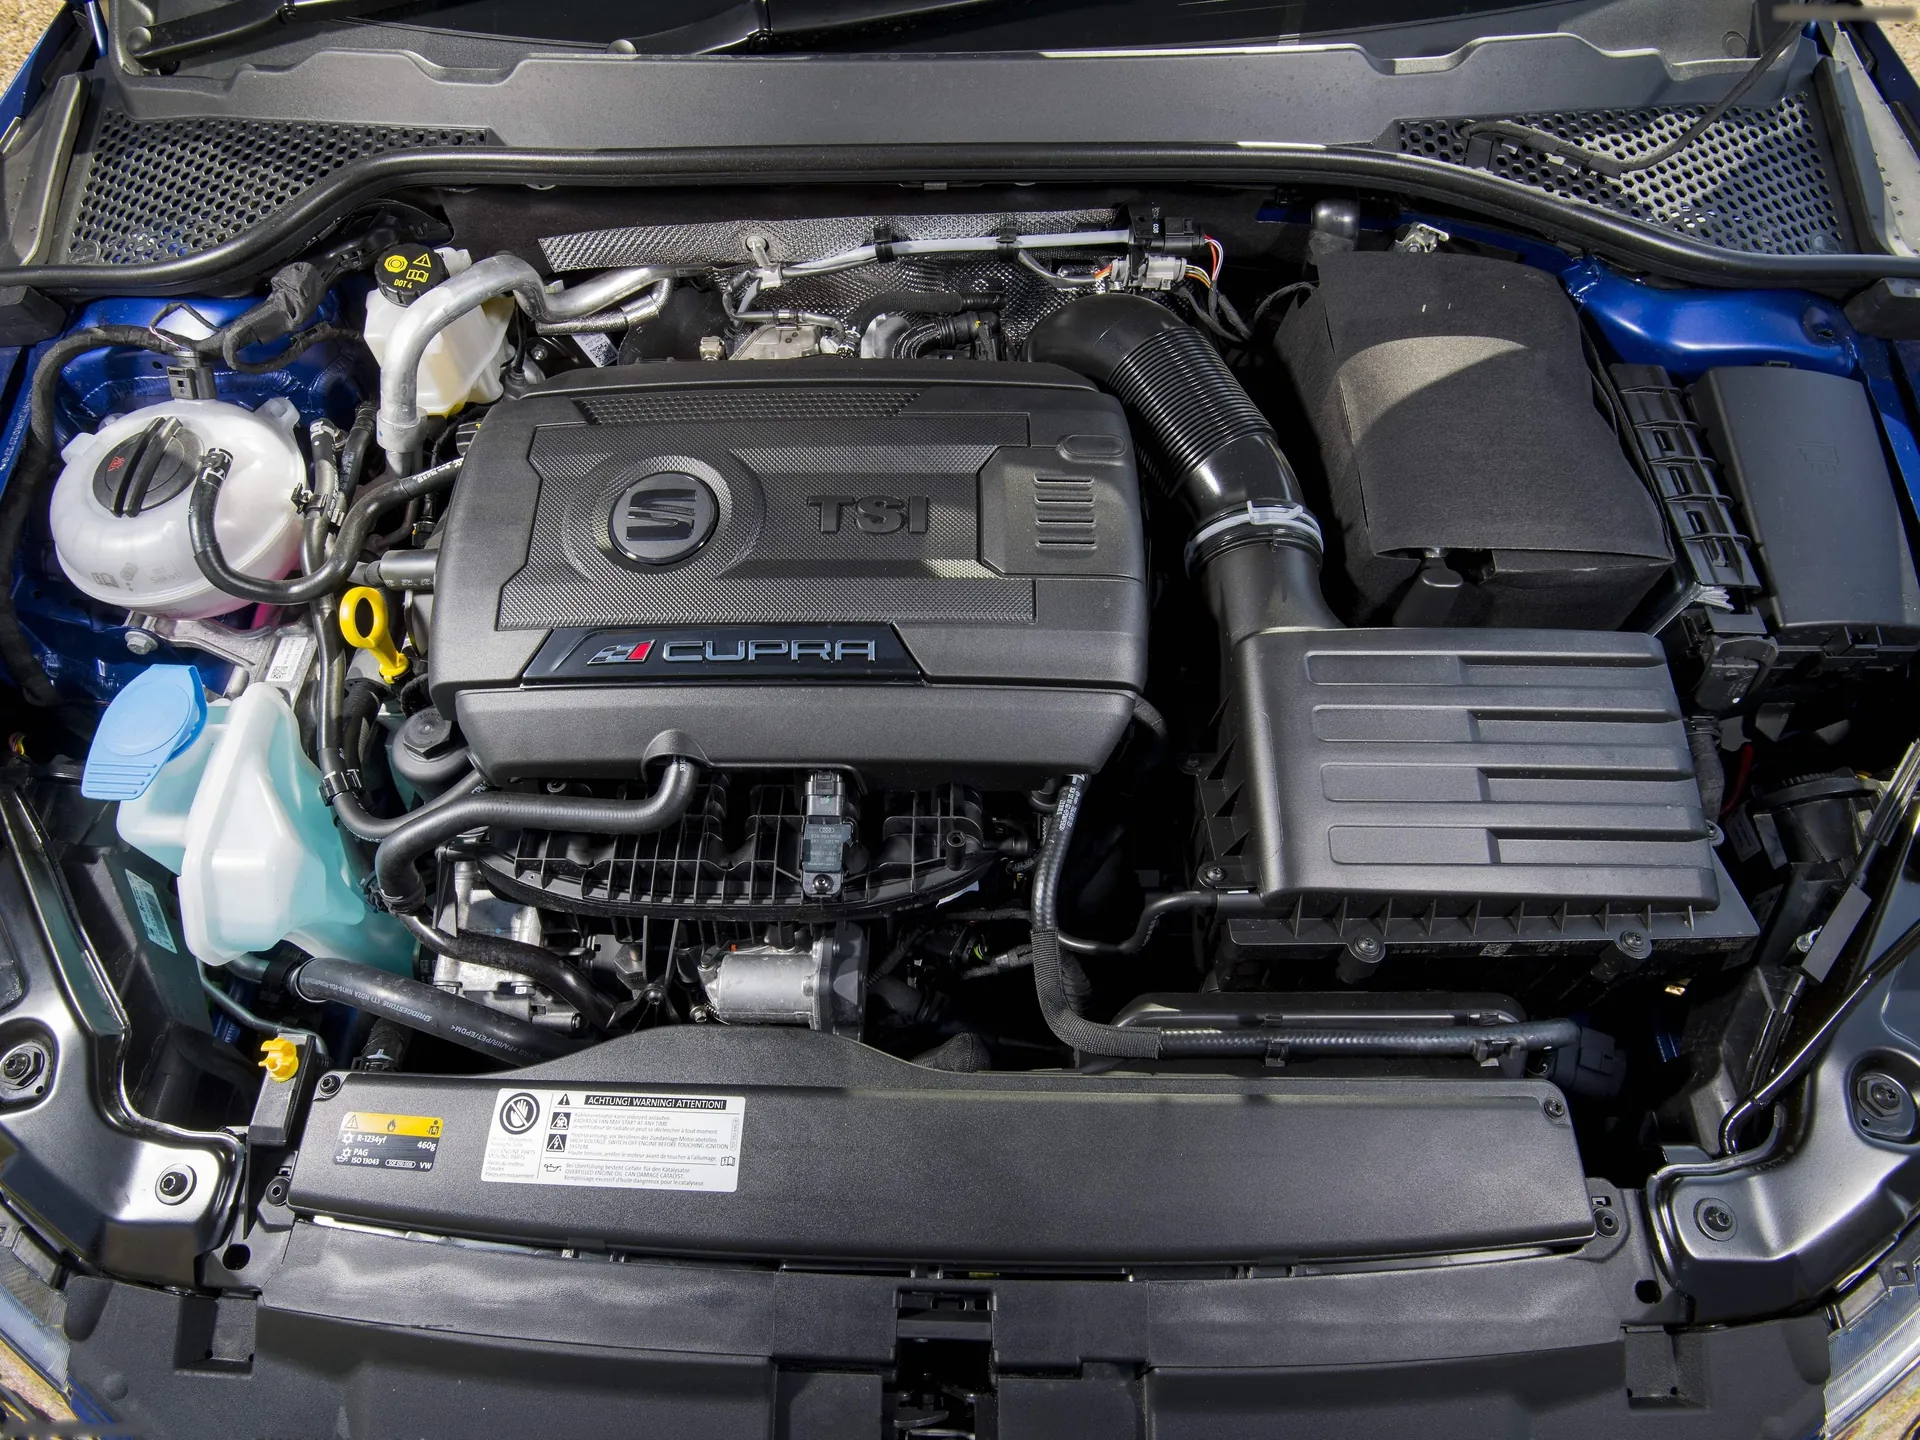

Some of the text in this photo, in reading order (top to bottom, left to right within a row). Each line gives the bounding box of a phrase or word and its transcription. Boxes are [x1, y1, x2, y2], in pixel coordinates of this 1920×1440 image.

[394, 279, 407, 287] DOT
[807, 494, 929, 534] TSI
[662, 639, 876, 663] CUPRA
[588, 1096, 724, 1109] ACHTUNG! WARNING! ATTENTION!
[357, 1134, 387, 1145] R-1234yf
[417, 1141, 436, 1151] 460g
[353, 1148, 368, 1156] PAG
[633, 1177, 659, 1185] dangereux
